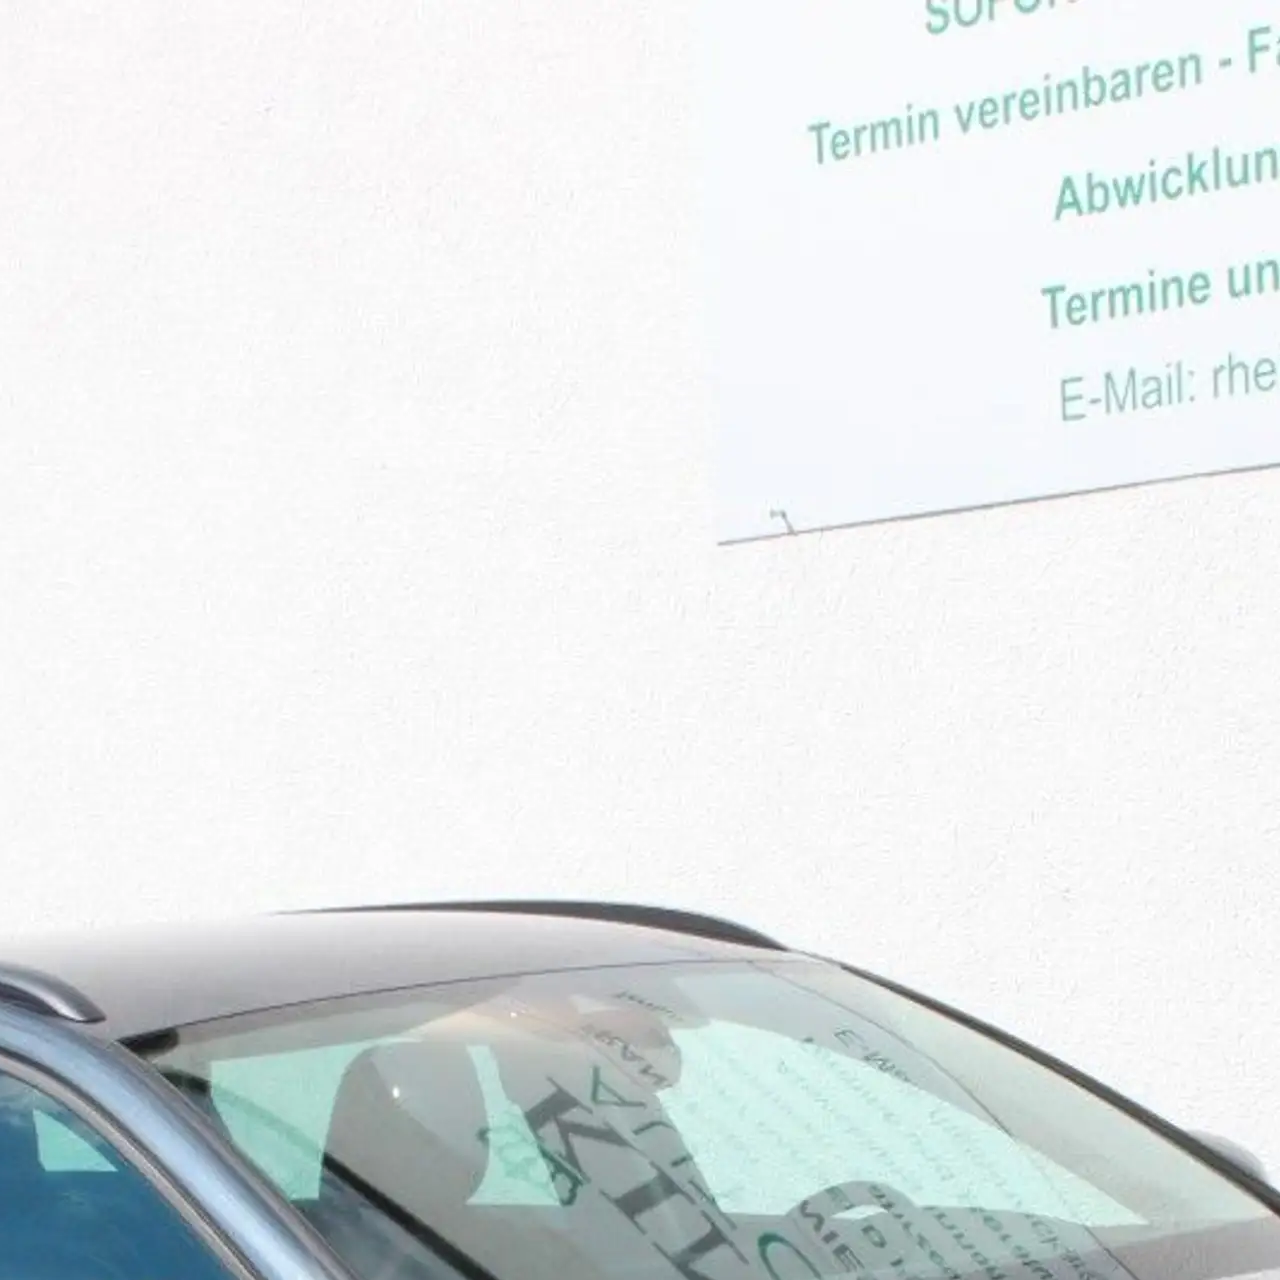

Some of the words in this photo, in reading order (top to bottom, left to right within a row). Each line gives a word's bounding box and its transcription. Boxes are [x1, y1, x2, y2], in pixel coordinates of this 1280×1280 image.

[807, 102, 940, 165] Termin
[953, 51, 1203, 135] vereinbaren
[1039, 268, 1212, 330] Termine
[1060, 360, 1196, 423] E-Mail:
